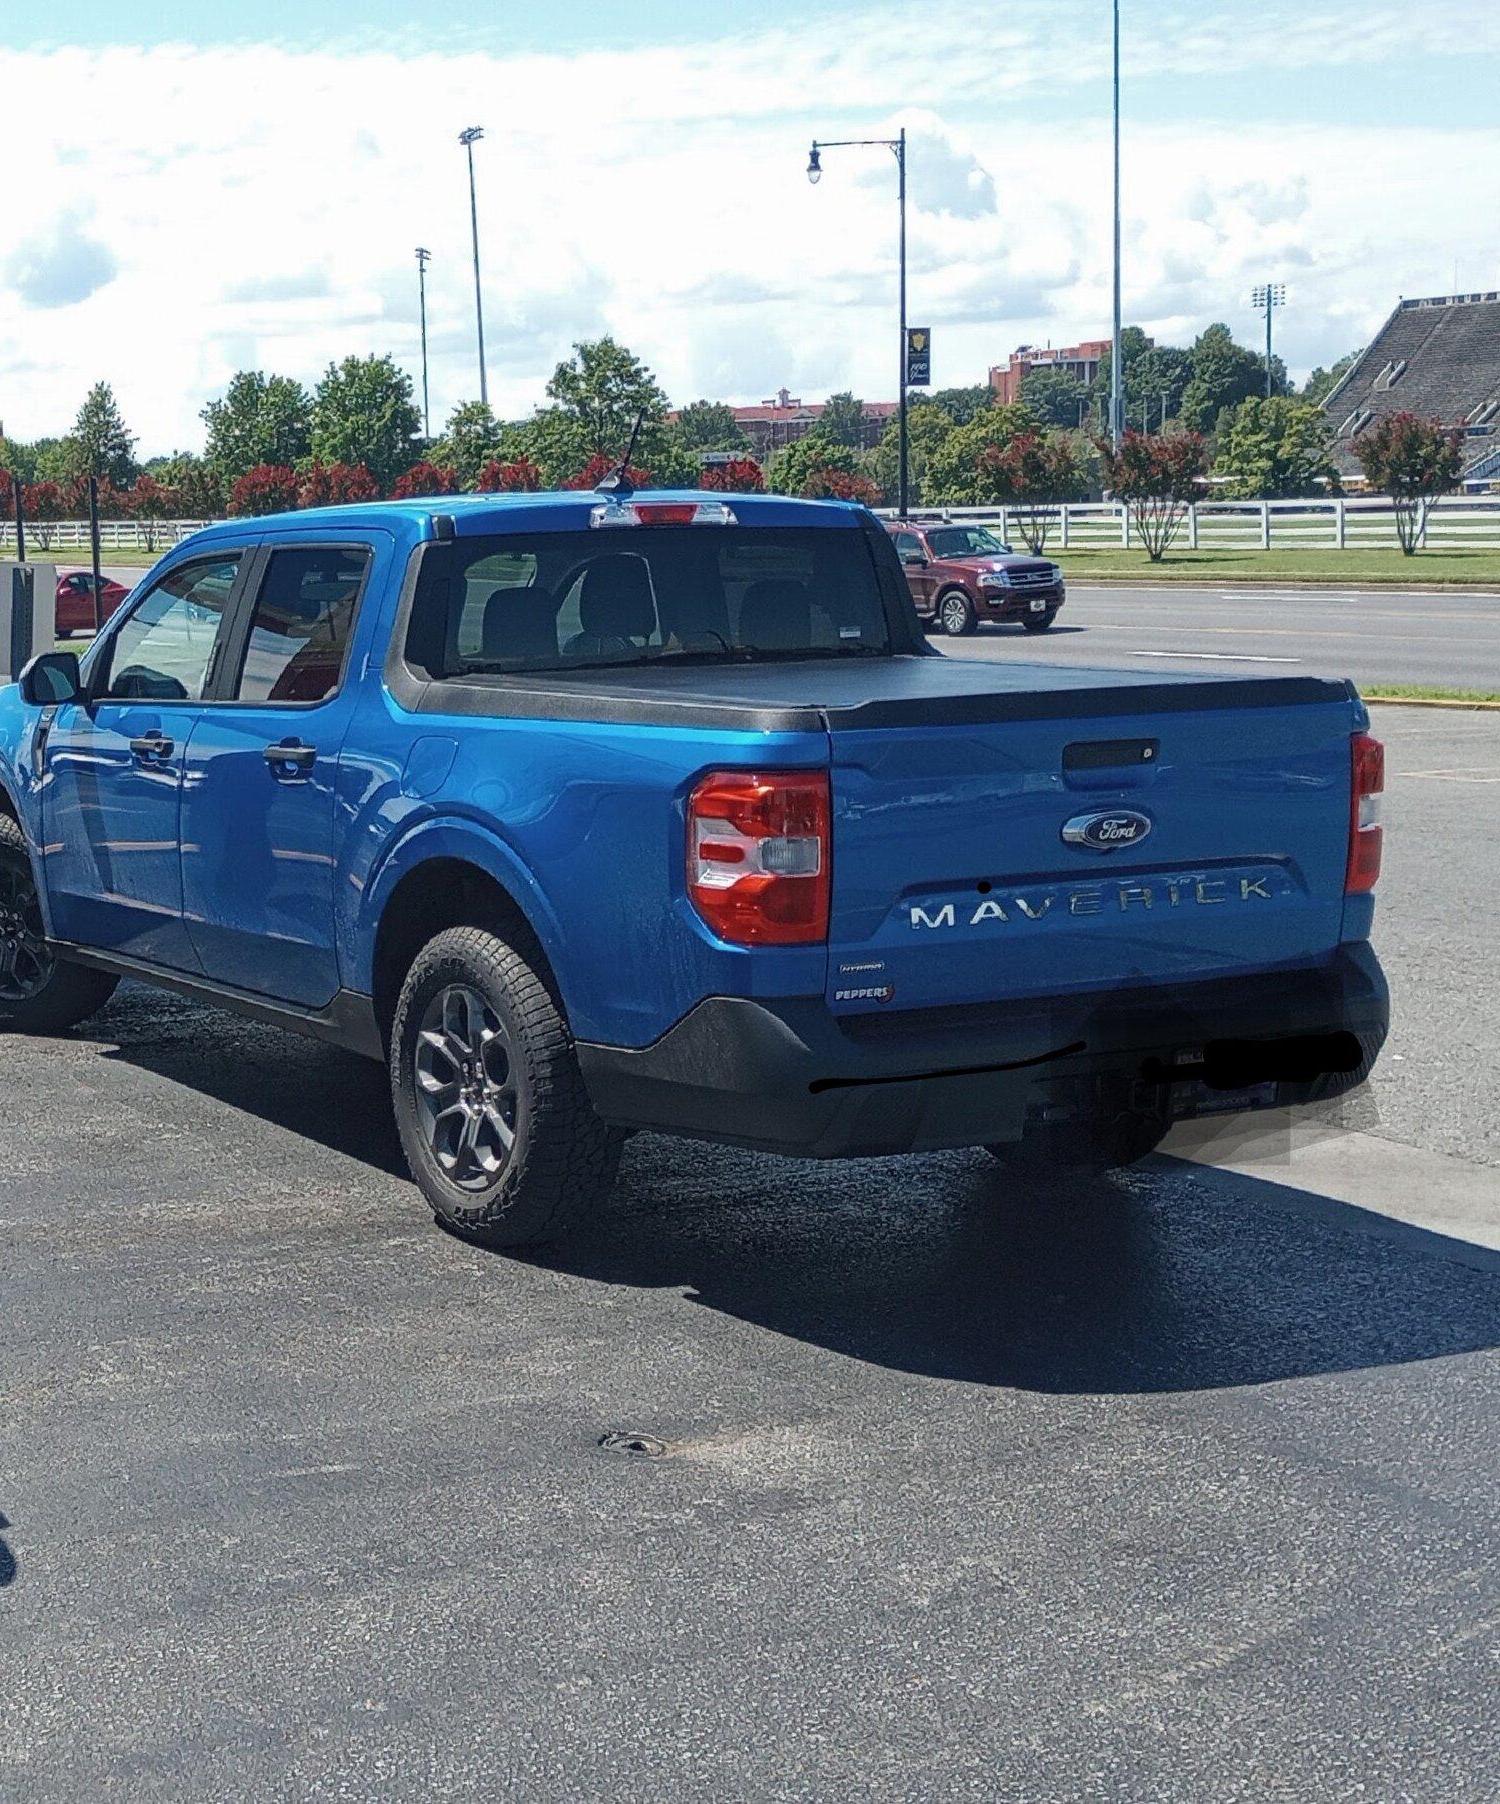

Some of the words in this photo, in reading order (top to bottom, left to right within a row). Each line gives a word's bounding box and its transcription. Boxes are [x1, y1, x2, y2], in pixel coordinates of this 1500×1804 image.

[1100, 818, 1136, 840] Ford
[910, 876, 1274, 930] MAVERICK
[835, 986, 889, 1000] PEPPERS
